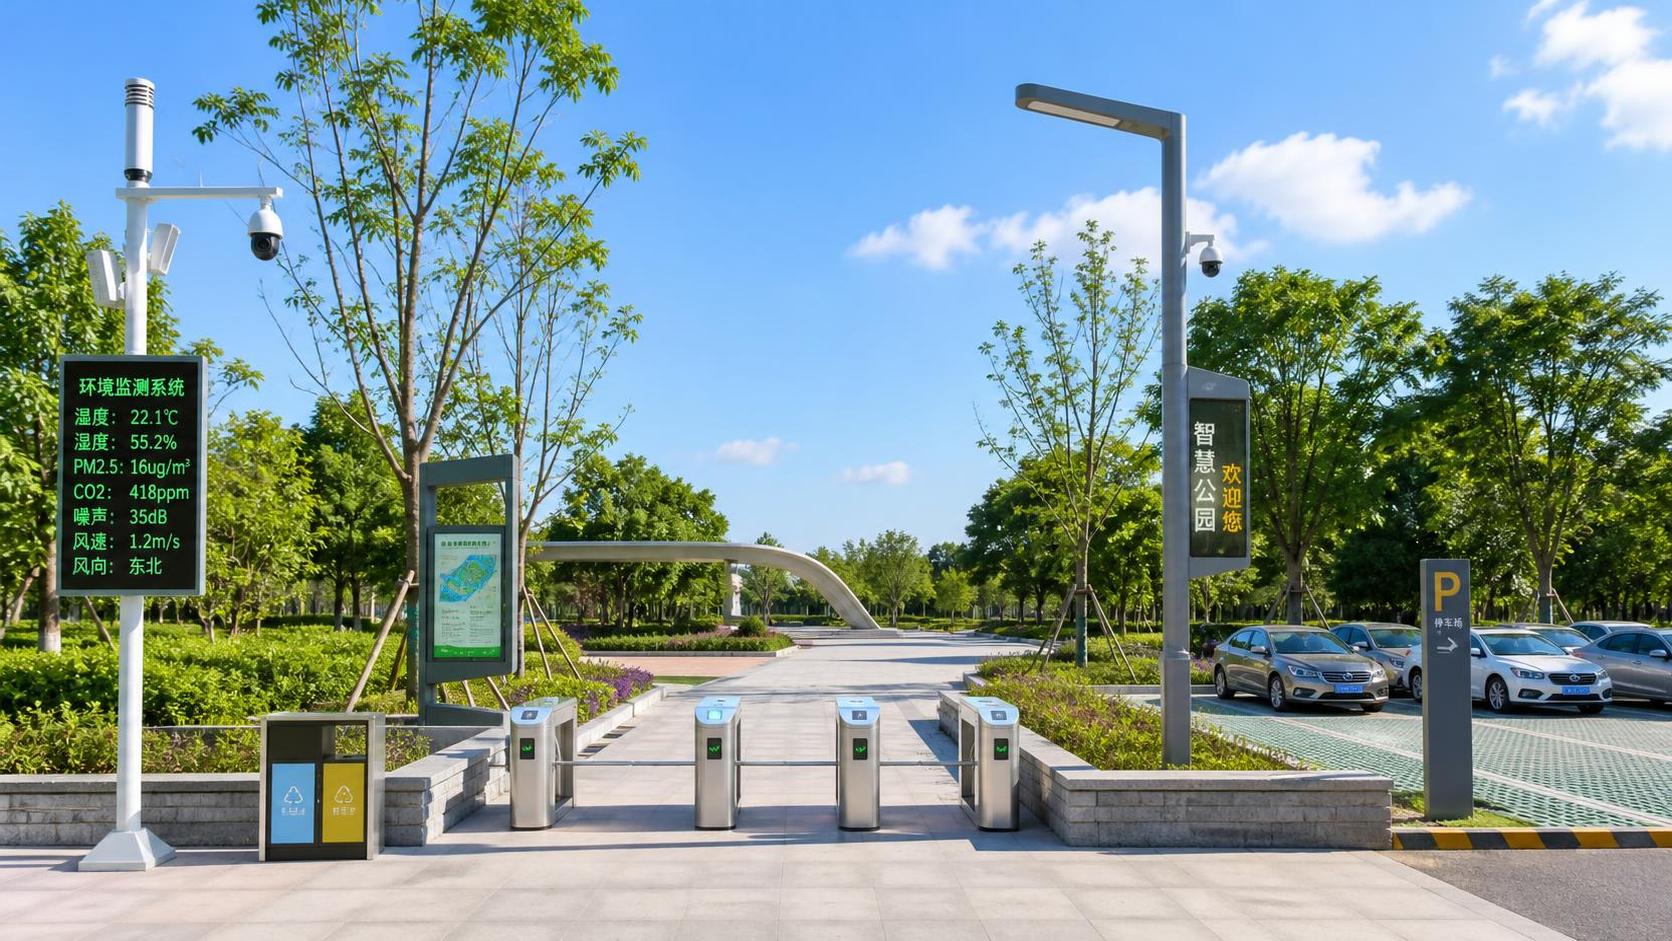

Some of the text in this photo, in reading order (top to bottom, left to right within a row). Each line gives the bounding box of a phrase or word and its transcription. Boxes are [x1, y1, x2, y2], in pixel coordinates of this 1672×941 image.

[79, 377, 185, 397] 环境监测系统
[130, 409, 178, 426] 22.1℃
[74, 432, 178, 452] 湿度： 55.2%
[73, 458, 124, 475] PM2.5:
[1194, 422, 1217, 533] 智慧公园
[73, 484, 190, 504] CO2: 418ppm
[1222, 463, 1243, 533] 欢迎您
[73, 507, 168, 527] 噪声： 35dB
[73, 532, 181, 552] 风速： 1.2m/s
[72, 556, 163, 576] 风向： 东北
[1434, 571, 1461, 612] P
